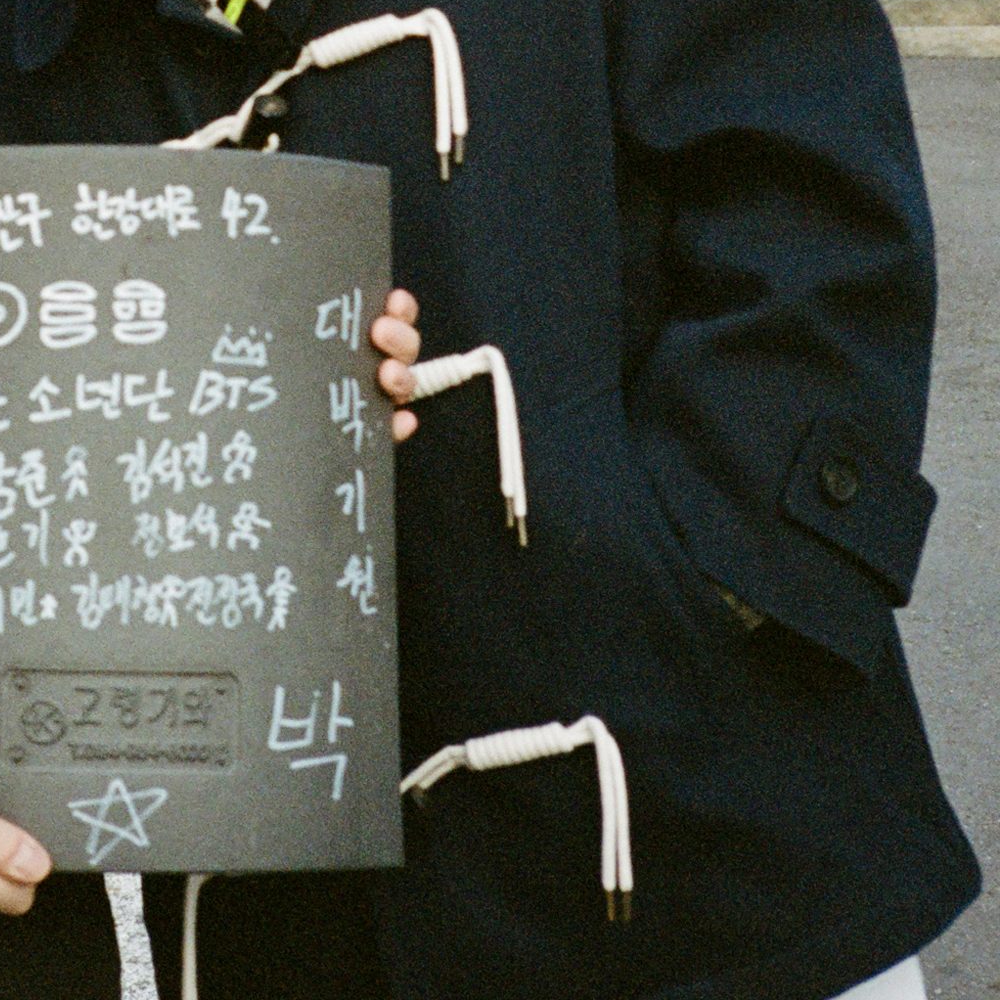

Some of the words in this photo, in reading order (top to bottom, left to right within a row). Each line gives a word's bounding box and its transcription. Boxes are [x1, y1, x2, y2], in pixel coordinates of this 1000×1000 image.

[69, 181, 203, 243] 한강대로
[27, 366, 177, 424] 소년단
[187, 367, 280, 418] BTS
[115, 431, 214, 505] 김석진
[267, 680, 355, 801] 박
